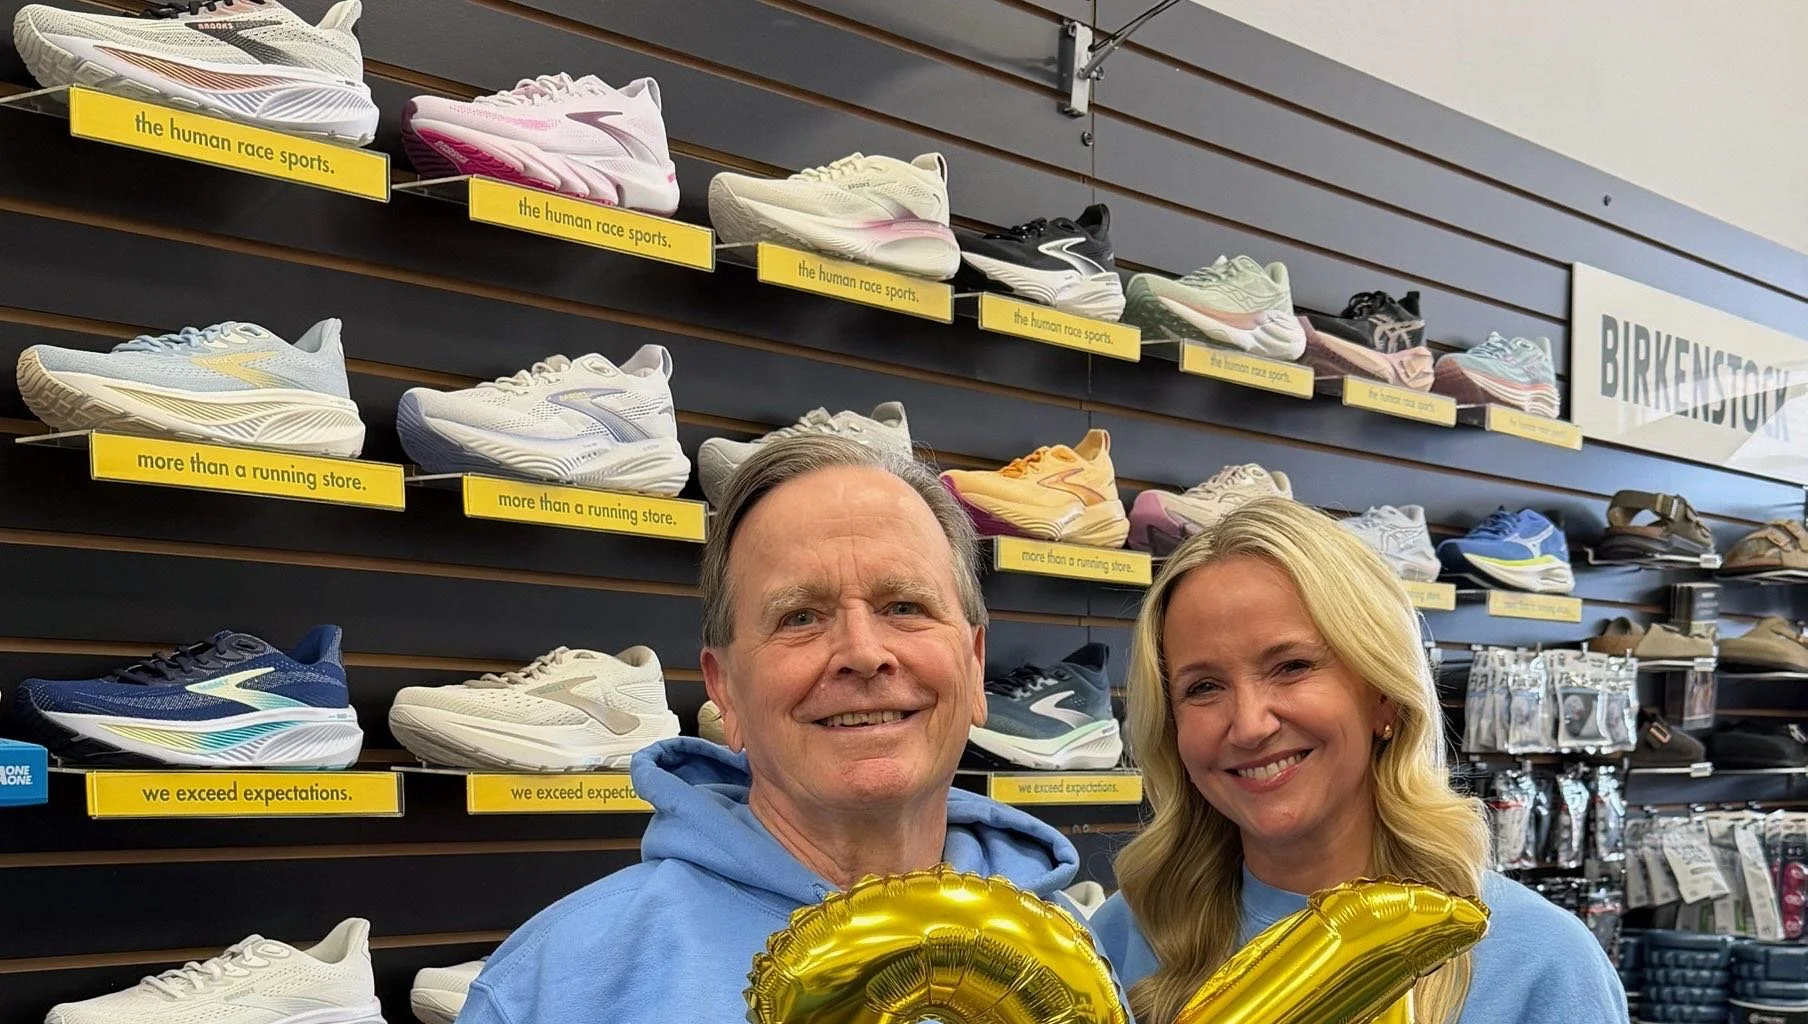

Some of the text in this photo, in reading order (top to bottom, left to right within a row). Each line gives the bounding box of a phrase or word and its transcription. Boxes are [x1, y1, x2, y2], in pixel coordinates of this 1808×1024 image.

[135, 111, 335, 175] the human race sports.
[518, 196, 672, 249] the human race sports.
[798, 260, 919, 302] the human race sports.
[1014, 308, 1114, 345] the human race sports.
[1600, 313, 1790, 443] BIRKENSTOCK
[137, 452, 367, 491] more than a running store.
[498, 492, 677, 527] more than a running store.
[1021, 549, 1134, 574] more than a running store.
[5, 765, 31, 776] ONE
[1018, 779, 1119, 797] we exceed expectations.
[141, 781, 353, 807] we exceed expectations.
[511, 782, 637, 804] we exceed expecta
